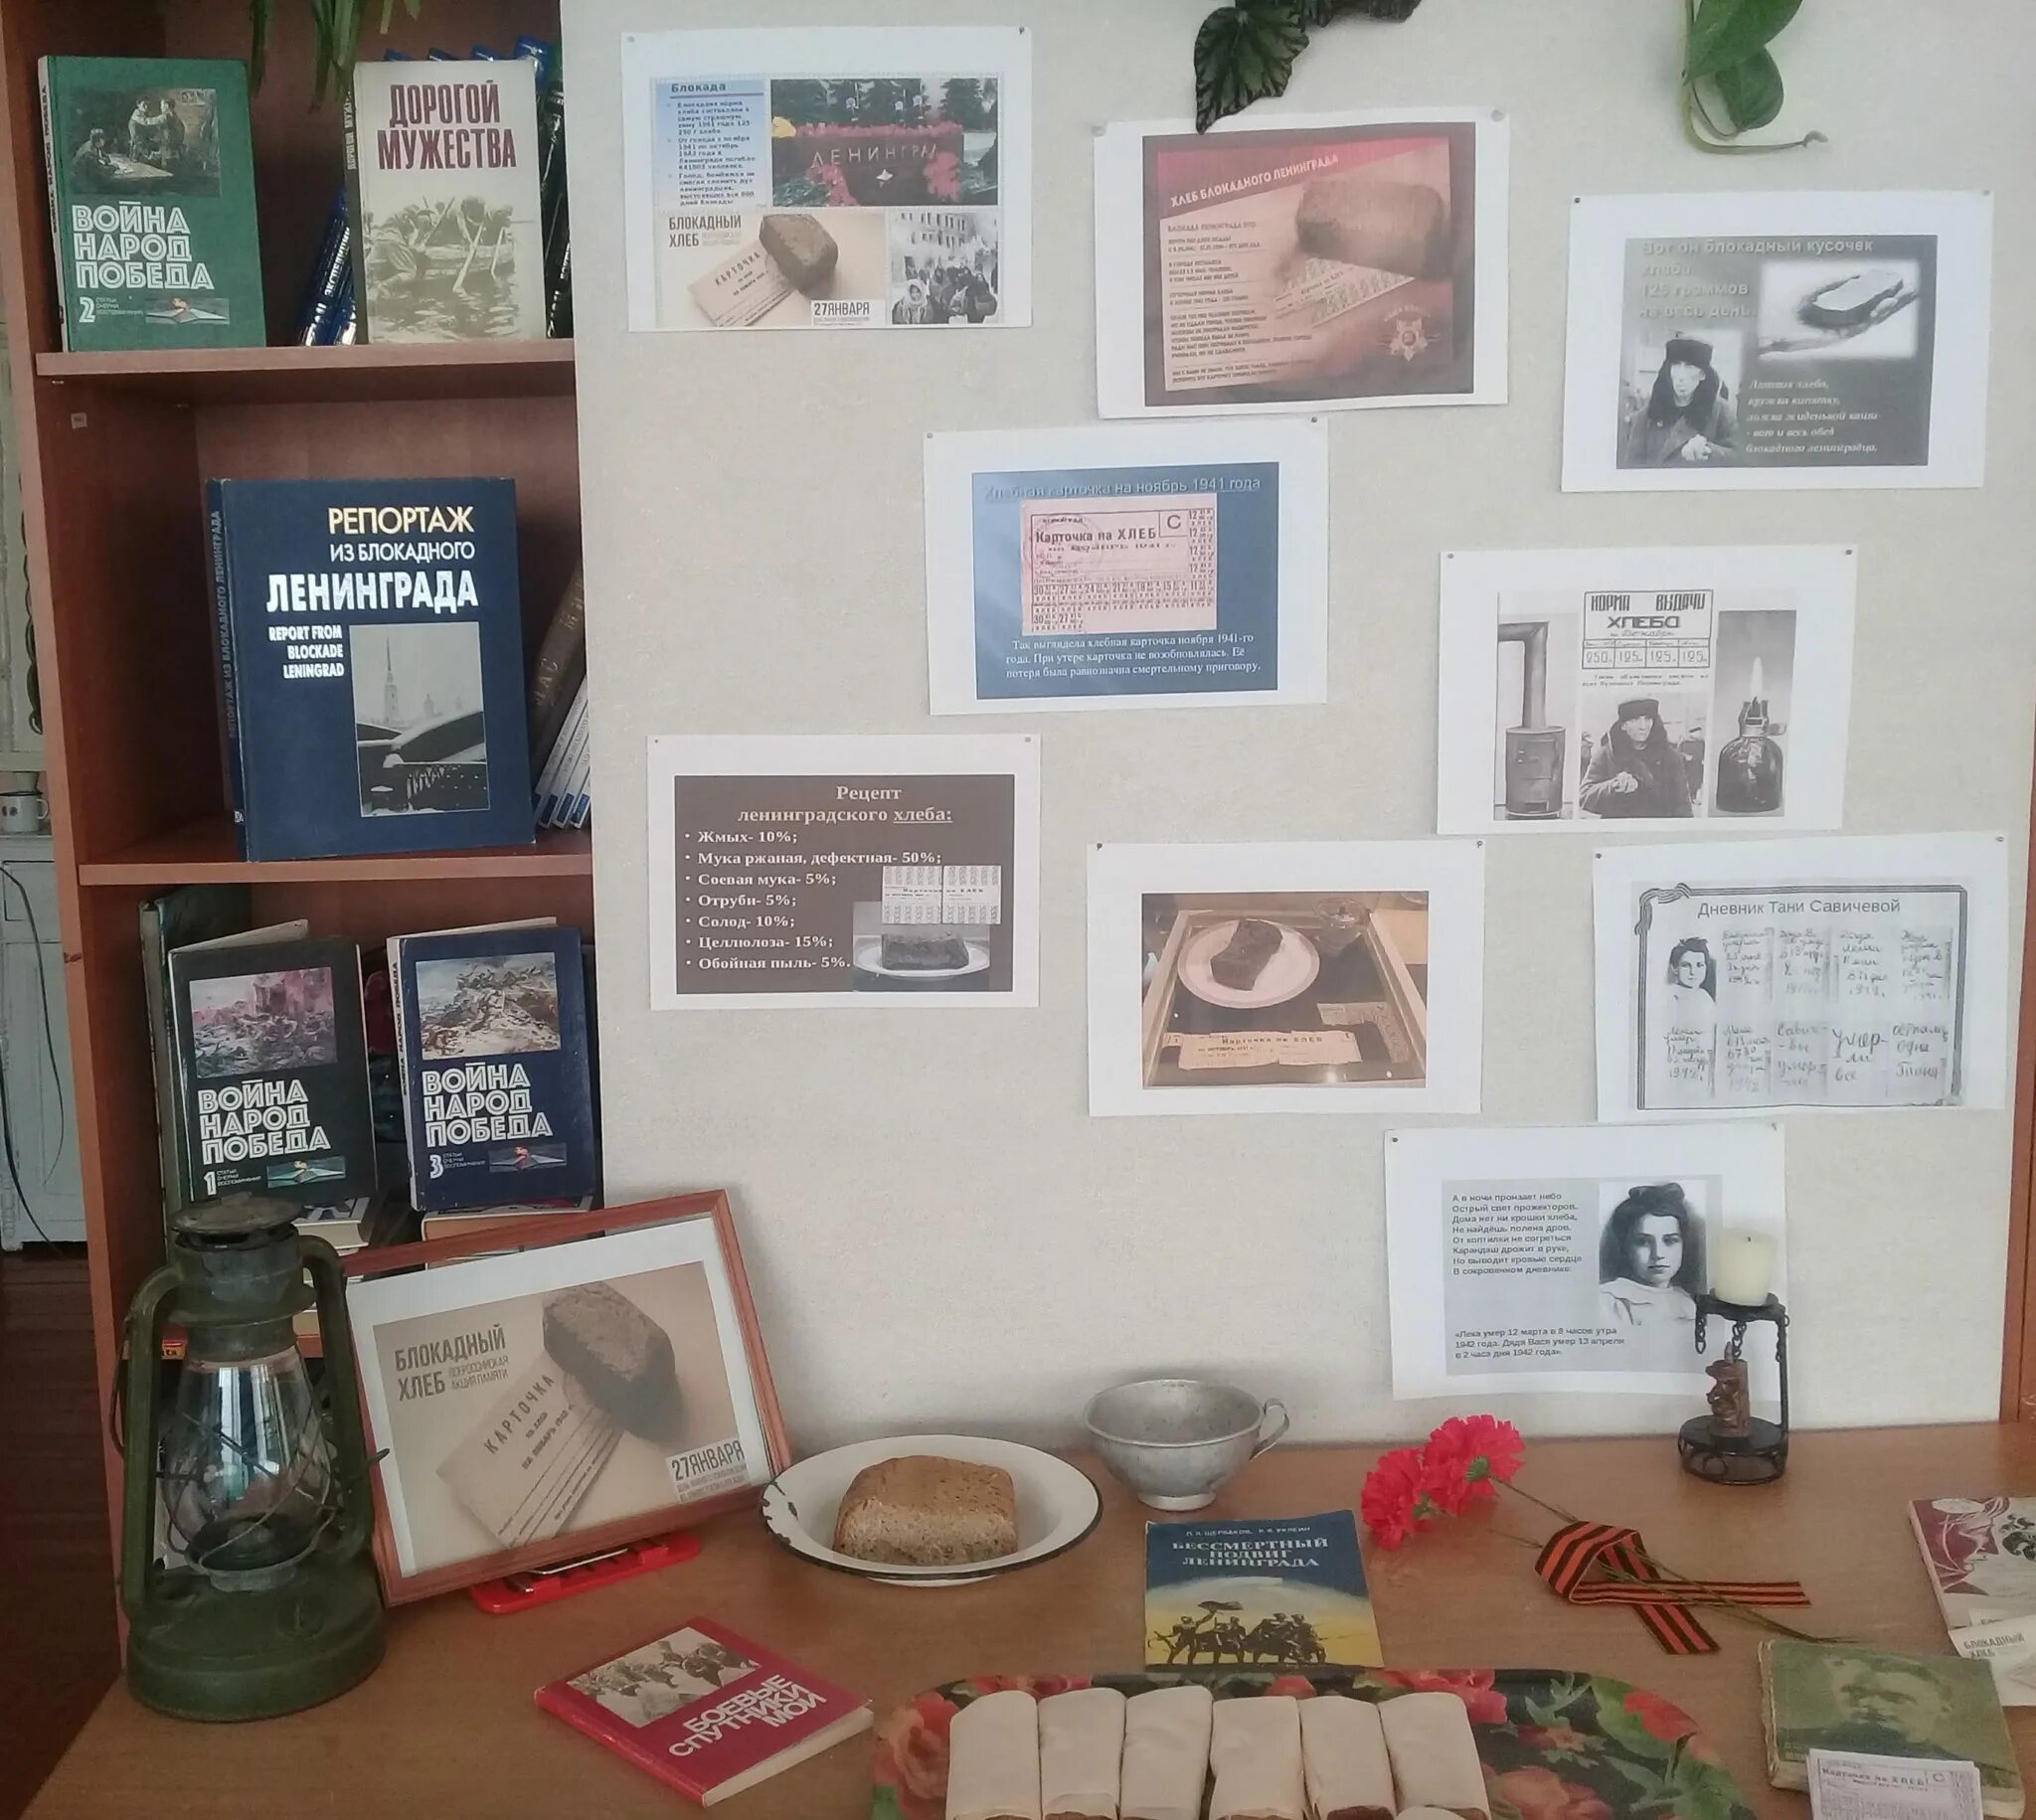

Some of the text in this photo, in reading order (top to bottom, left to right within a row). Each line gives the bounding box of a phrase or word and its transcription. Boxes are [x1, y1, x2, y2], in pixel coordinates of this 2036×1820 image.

[671, 83, 726, 92] Блокада
[389, 80, 500, 128] ДОРОГОЙ
[377, 128, 517, 170] МУЖЕСТВА
[1170, 153, 1339, 208] ХЛЕБ БЛОКАДНОГО ЛЕНИНГРАДА
[72, 200, 191, 235] ВОЙНА
[669, 215, 742, 231] БЛОКАДНЫЙ
[73, 233, 192, 262] НАРОД
[669, 233, 700, 248] ХЛЕБ
[1704, 239, 1873, 255] блокадный кусочек
[76, 260, 215, 289] ПОБЕДА
[80, 296, 95, 323] 2
[1745, 442, 1805, 453] блокадного
[1114, 477, 1261, 494] на ноябрь 1941 года
[328, 506, 475, 535] РЕПОРТАЖ
[1036, 527, 1157, 546] Карточка на ХЛЕБ
[330, 541, 475, 565] ИЗ БЛОКАДНОГО
[266, 570, 479, 614] ЛЕНИНГРАДА
[1591, 592, 1706, 611] НОРМА ВЫДАЧИ
[268, 623, 343, 642] REPORT FROM
[1011, 633, 1255, 650] Так выглядела хлебная карточка ноября 1941-го
[287, 644, 344, 659] BLOCKADE
[1033, 653, 1054, 665] При
[1057, 655, 1085, 665] утере
[1087, 652, 1132, 663] карточка
[1148, 649, 1229, 660] возобновлялась.
[283, 663, 345, 679] LENINGRAD
[1006, 662, 1261, 680] потеря была равнозначна смертельному приговору.
[836, 785, 902, 802] Рецепт
[738, 806, 952, 824] ленинградского хлеба:
[698, 830, 797, 845] Жмых- 10%;
[698, 851, 942, 866] Мука ржаная, дефектная- 50%;
[699, 872, 837, 889] Соевая мука- 5%;
[699, 894, 797, 909] Отруби- 5%;
[1698, 899, 1901, 918] Дневник Тани Савичевой
[699, 913, 795, 929] Солод- 10%;
[699, 935, 833, 950] Целлюлоза- 15%;
[699, 954, 851, 970] Обойная пыль- 5%.
[422, 1062, 531, 1096] ВОЙНА
[198, 1078, 309, 1114] ВОЙНА
[424, 1088, 533, 1122] НАРОД
[199, 1104, 310, 1140] НАРОД
[425, 1111, 553, 1148] ПОБЕДА
[201, 1126, 331, 1166] ПОБЕДА
[429, 1154, 443, 1179] 3
[204, 1171, 217, 1196] 1
[1495, 1194, 1536, 1203] пронзает
[1452, 1205, 1488, 1214] Острый
[1452, 1216, 1476, 1225] Дома
[1547, 1214, 1578, 1223] хлеба,
[1524, 1235, 1572, 1243] согреться
[1452, 1245, 1534, 1255] Карандаш дрожит
[1549, 1255, 1582, 1264] сердце
[1462, 1266, 1523, 1275] сокровенном
[395, 1323, 505, 1371] БЛОКАДНЫЙ
[1502, 1339, 1526, 1348] Дядя
[1553, 1338, 1576, 1347] умер
[477, 1369, 508, 1385] ПАМЯТИ
[398, 1371, 445, 1402] ХЛЕБ
[484, 1374, 556, 1455] КАРТОЧКА
[1172, 1537, 1328, 1551] БЕССМЕРТНЫЙ
[1182, 1558, 1320, 1568] ЛЕНИНГРАДА
[1210, 1550, 1292, 1560] ПОДВИГ
[683, 1674, 788, 1731] БОЕВЫЕ
[762, 1692, 827, 1729] МОИ
[668, 1684, 810, 1757] СПУТНИКИ
